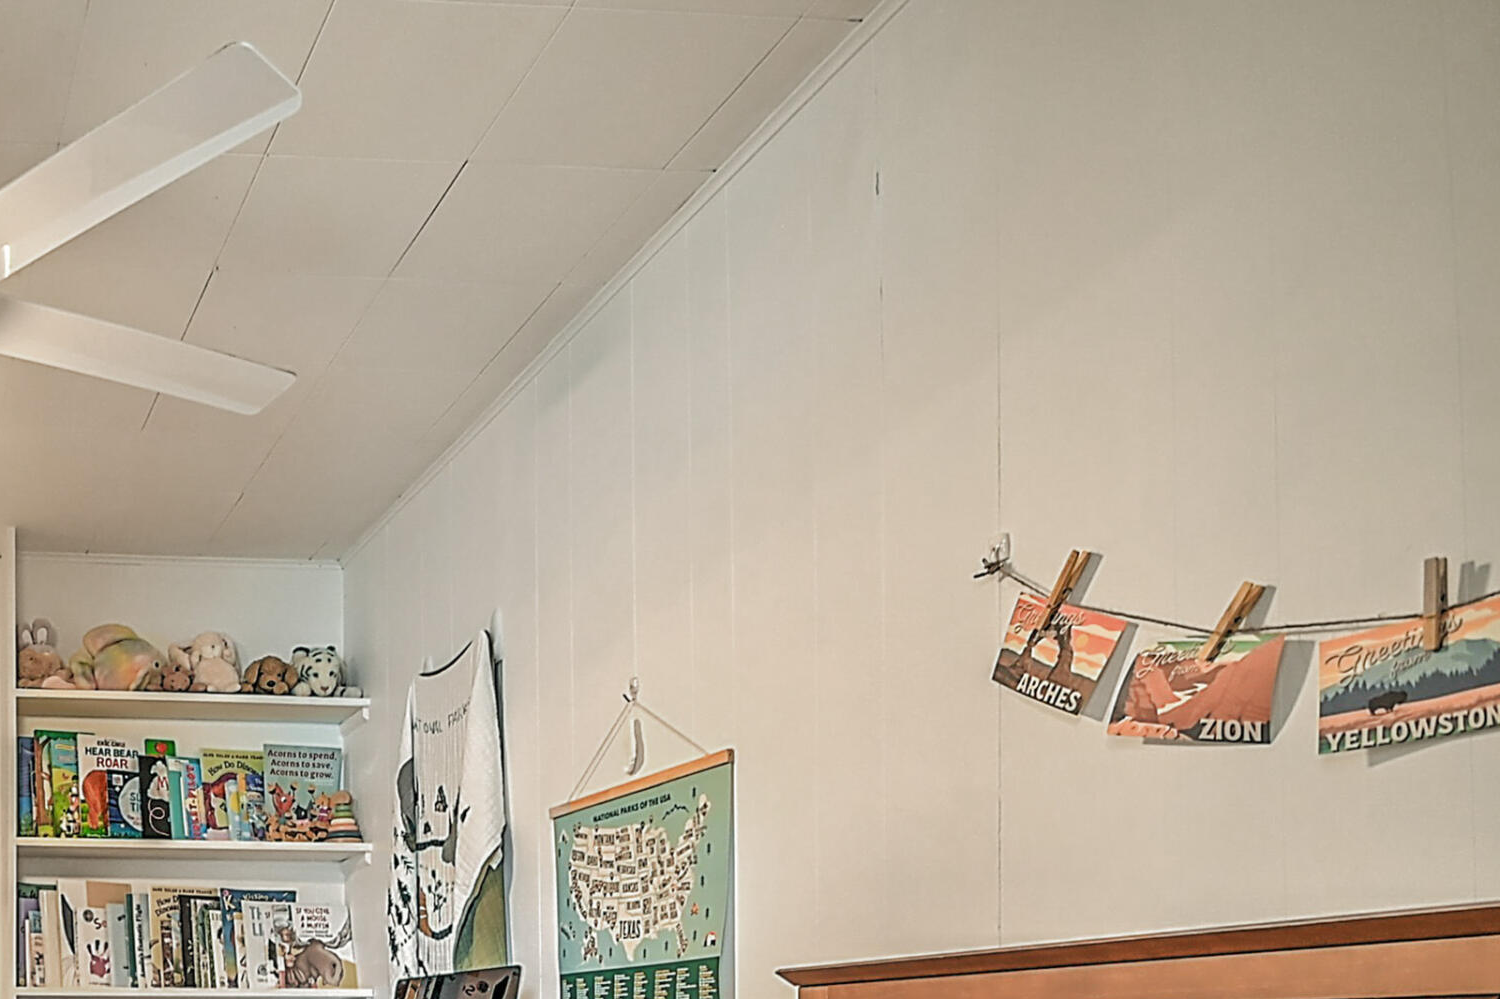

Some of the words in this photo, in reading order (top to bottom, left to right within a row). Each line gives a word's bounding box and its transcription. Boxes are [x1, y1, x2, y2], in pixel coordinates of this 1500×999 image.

[1016, 673, 1082, 712] ARCHES
[1199, 719, 1263, 742] ZION
[85, 747, 111, 757] HEAR
[113, 748, 139, 759] BEAR
[267, 749, 297, 758] Acorns
[298, 750, 308, 759] to
[96, 757, 128, 769] ROAR
[224, 760, 235, 769] Do
[270, 758, 300, 768] Acorns
[301, 760, 311, 768] to
[269, 768, 299, 777] Acorns
[300, 769, 310, 777] to
[593, 808, 620, 822] NATIONAL
[620, 802, 639, 815] PARKS
[640, 799, 648, 809] OF
[649, 796, 658, 807] THE
[660, 793, 671, 804] USA
[619, 920, 641, 939] TEXAS
